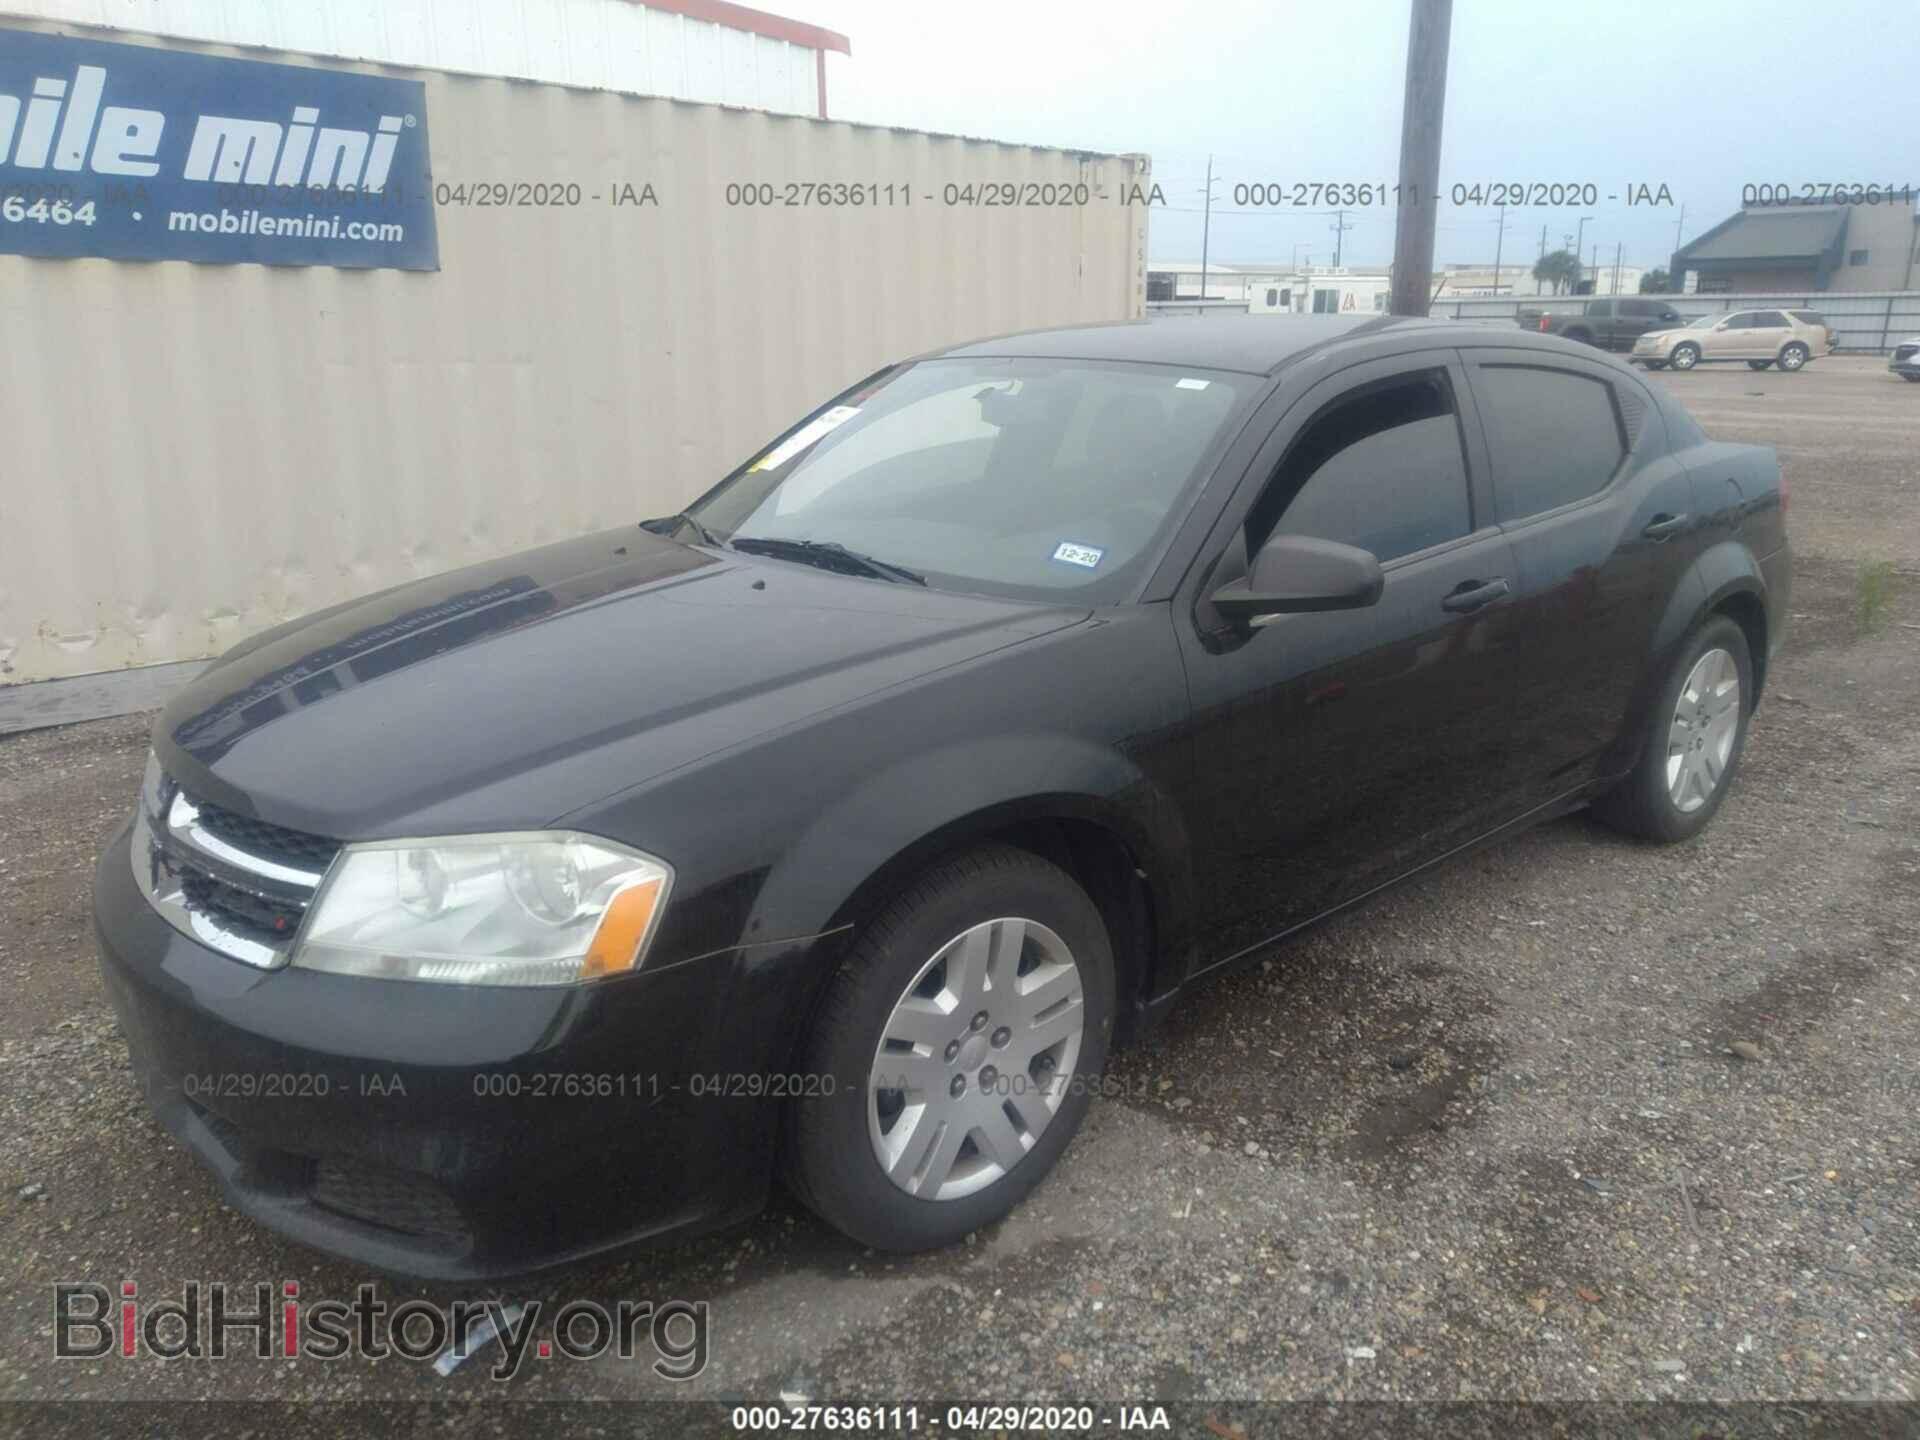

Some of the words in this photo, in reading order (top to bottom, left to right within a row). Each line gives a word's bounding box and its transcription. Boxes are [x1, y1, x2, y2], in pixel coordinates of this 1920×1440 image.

[3, 197, 96, 226] 6464
[168, 209, 404, 242] mobilemini.com
[1061, 547, 1098, 563] 12-20
